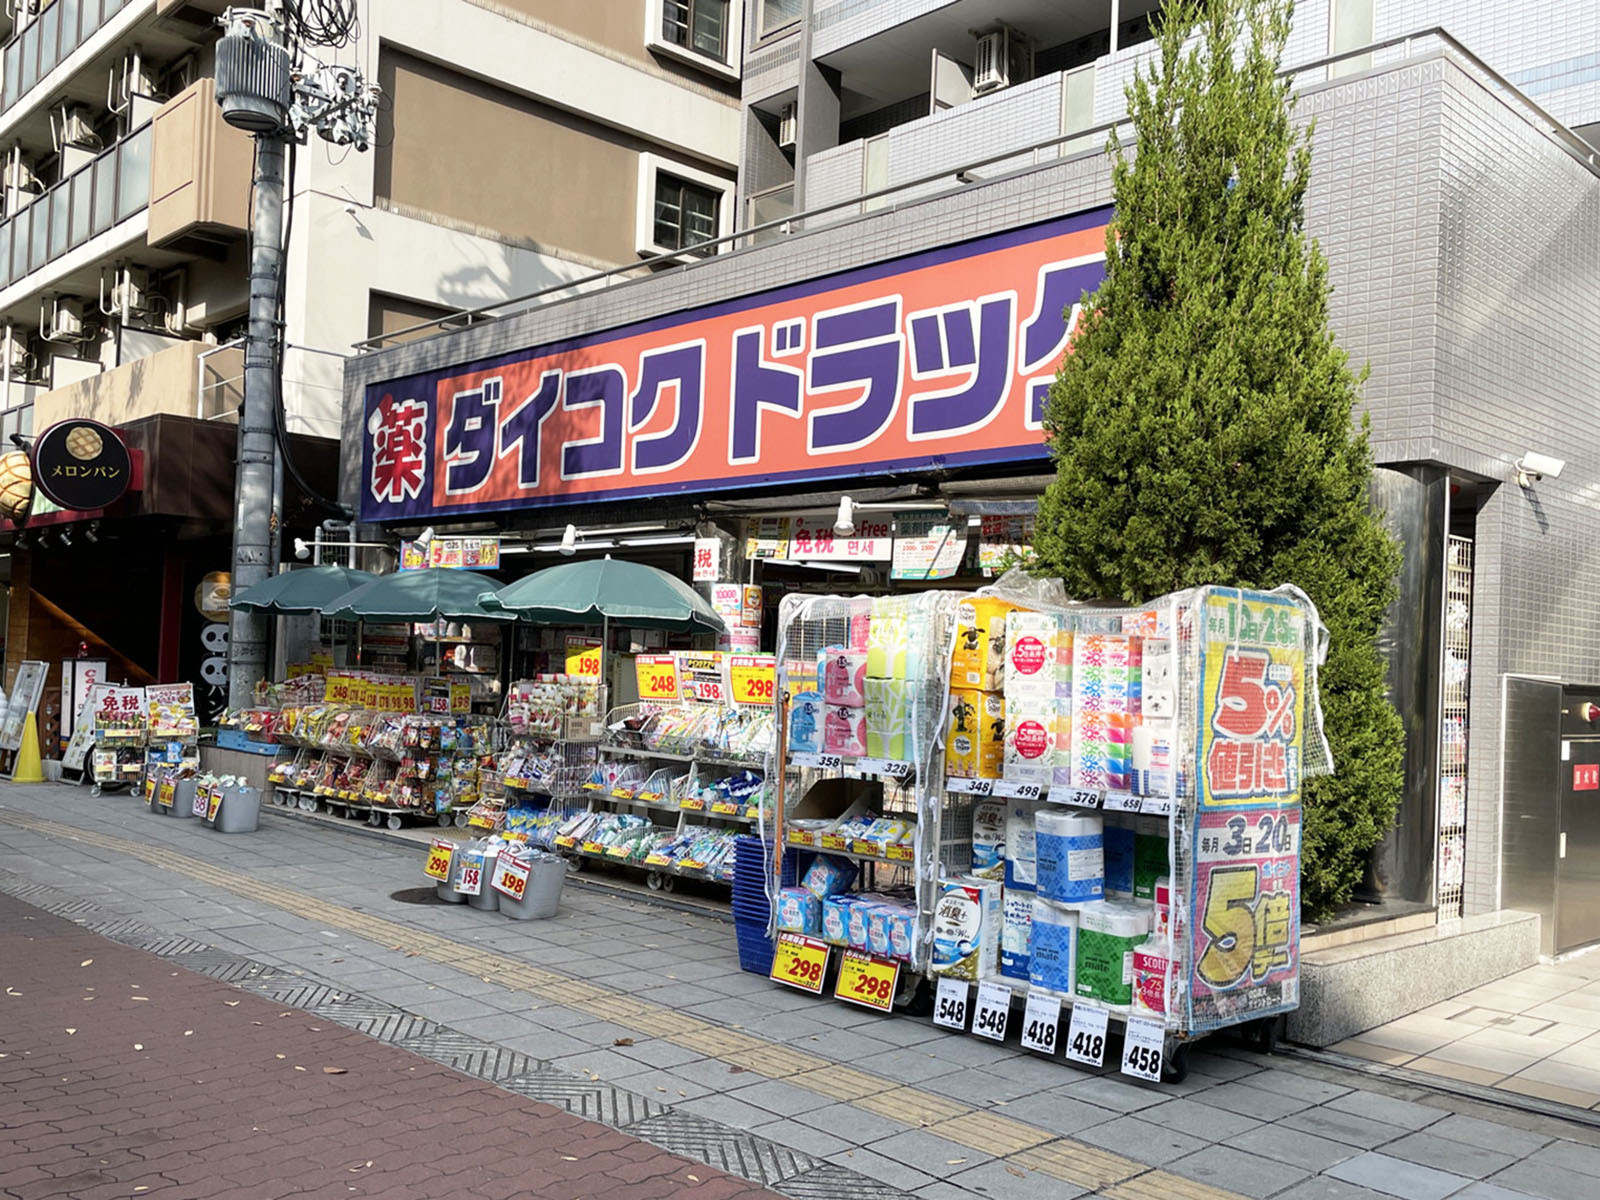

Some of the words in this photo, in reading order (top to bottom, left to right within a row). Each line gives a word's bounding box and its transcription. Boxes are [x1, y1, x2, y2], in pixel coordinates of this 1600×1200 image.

[444, 335, 708, 496] ダイコク
[369, 397, 428, 503] 薬
[52, 464, 120, 480] メロンパン
[794, 527, 834, 554] 免税
[578, 657, 600, 675] 198
[332, 684, 349, 699] 248
[650, 675, 675, 693] 248
[699, 682, 720, 700] 198
[746, 679, 774, 698] 298
[102, 695, 140, 712] 免税
[433, 695, 447, 710] 158
[818, 756, 840, 768] 358
[884, 762, 908, 775] 328
[968, 780, 990, 793] 348
[1016, 785, 1039, 798] 498
[1073, 791, 1097, 804] 378
[1122, 798, 1140, 809] 658
[428, 856, 448, 873] 298
[463, 868, 480, 885] 158
[501, 872, 525, 894] 198
[788, 957, 822, 982] 298
[854, 974, 891, 999] 298
[939, 997, 965, 1023] 548
[978, 1007, 1006, 1034] 548
[1027, 1019, 1055, 1047] 418
[1072, 1031, 1103, 1060] 418
[1128, 1045, 1161, 1074] 458
